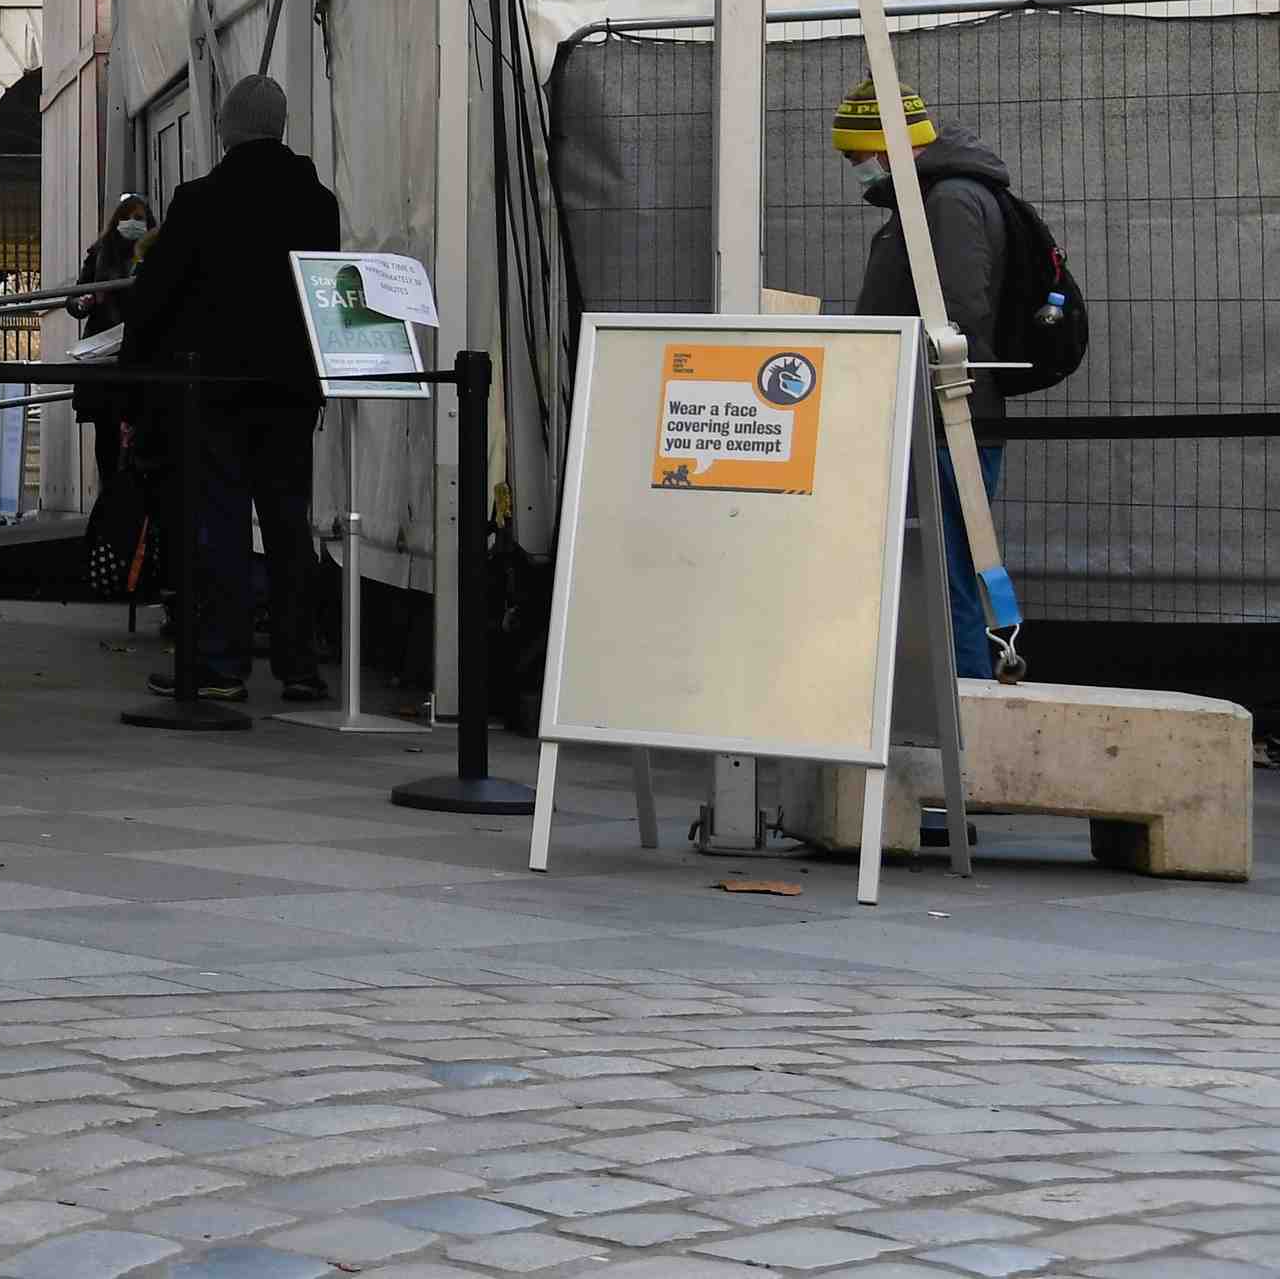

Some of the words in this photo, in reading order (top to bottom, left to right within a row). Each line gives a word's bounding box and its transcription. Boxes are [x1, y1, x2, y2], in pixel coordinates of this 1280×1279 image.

[311, 275, 337, 287] Stay
[326, 331, 399, 348] APART
[669, 401, 706, 416] Wear
[710, 404, 720, 416] a
[724, 402, 758, 417] face
[667, 419, 730, 437] covering
[734, 420, 782, 435] unless
[665, 438, 691, 452] you
[695, 439, 721, 450] are
[726, 439, 782, 455] exempt
